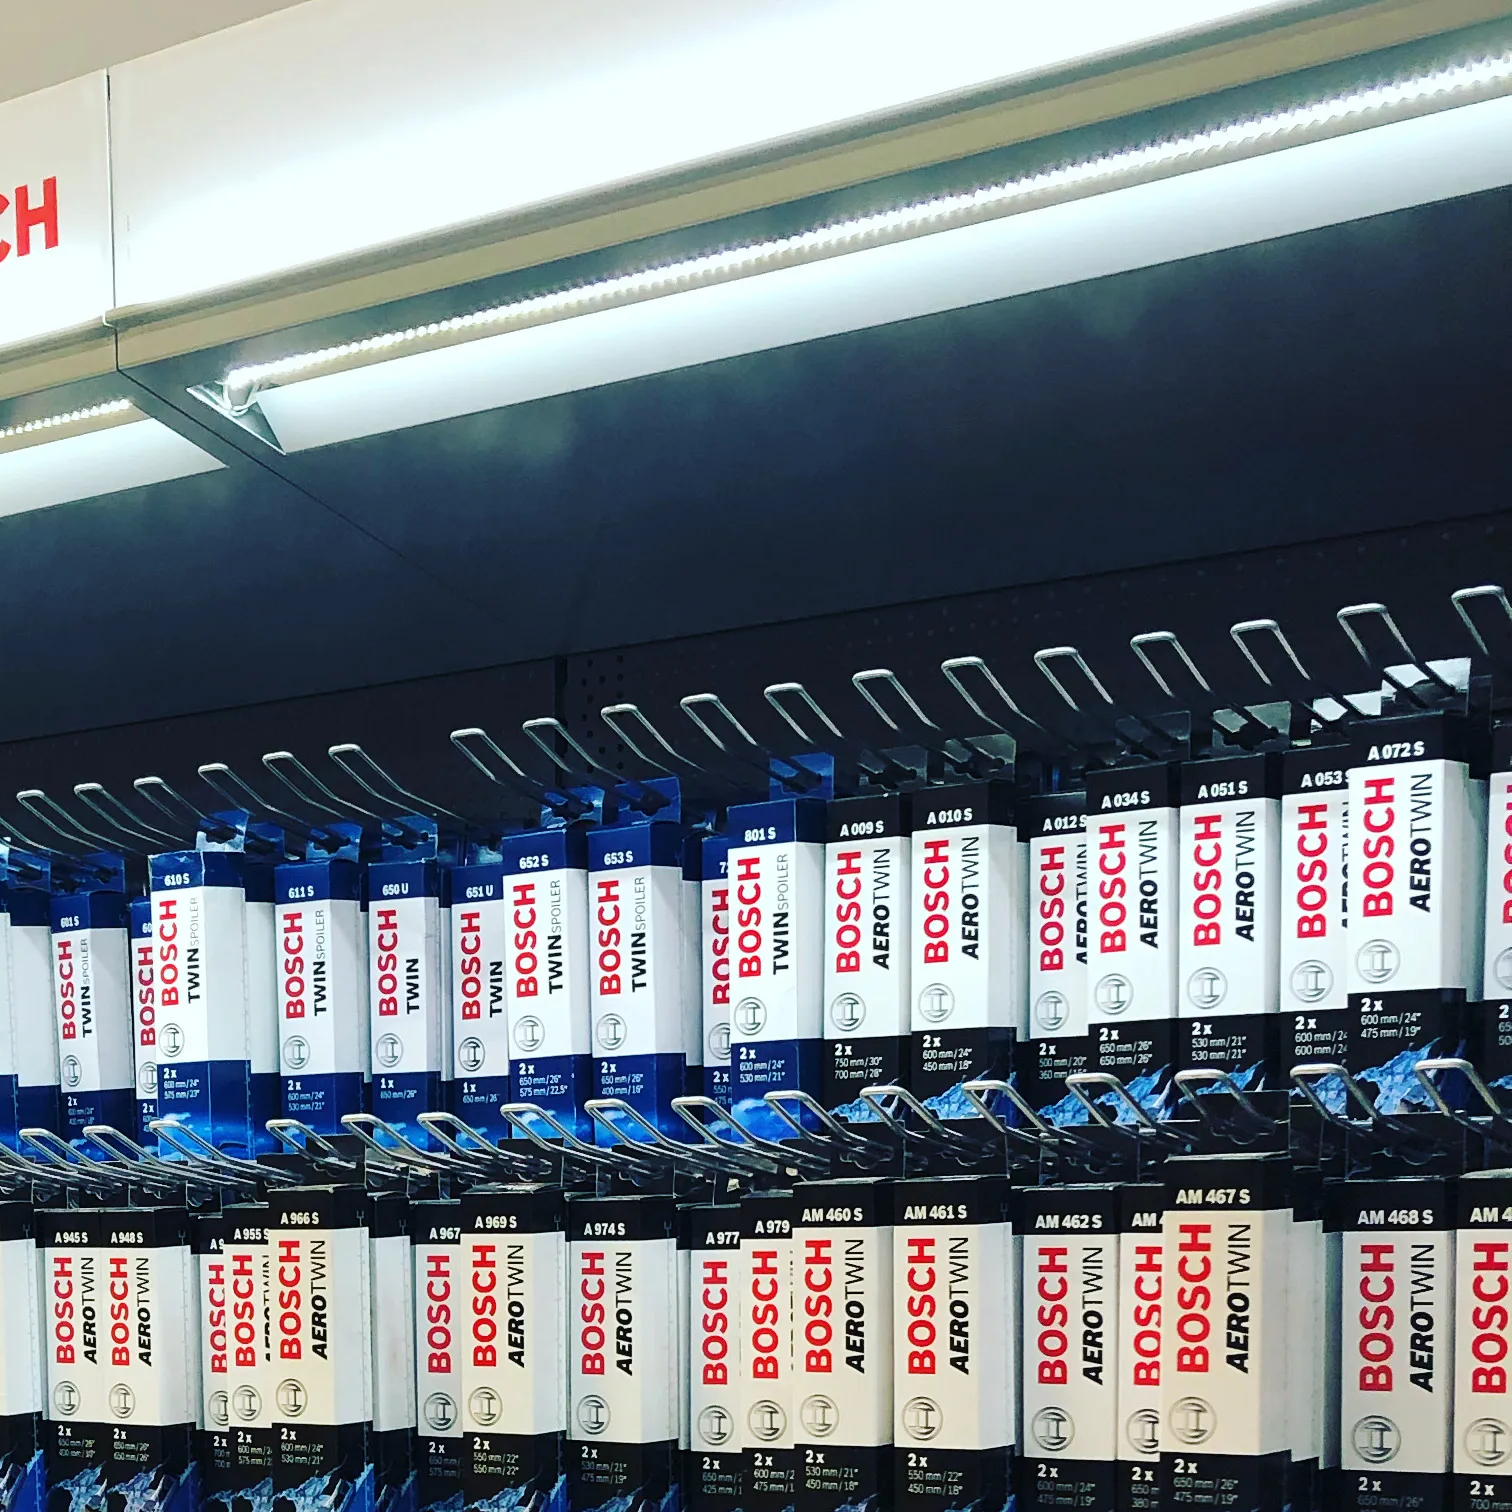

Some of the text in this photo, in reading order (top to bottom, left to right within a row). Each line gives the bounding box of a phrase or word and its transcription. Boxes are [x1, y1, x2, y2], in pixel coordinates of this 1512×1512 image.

[1198, 781, 1247, 798] A 051 S
[1368, 741, 1424, 760] A 072 S
[520, 855, 548, 869] 652 S
[745, 827, 776, 842] 801 S
[927, 808, 972, 824] A 010 S
[1364, 778, 1394, 916] BOSCH
[1410, 774, 1432, 912] AEROTWIN
[164, 873, 189, 886] 610 S
[466, 885, 493, 898] 651 U
[738, 858, 761, 977] BOSCH
[924, 840, 949, 963] BOSCH
[962, 837, 979, 960] AEROTWIN
[1194, 815, 1221, 946] BOSCH
[1236, 811, 1255, 941] AEROTWIN
[160, 900, 179, 1006] BOSCH
[462, 912, 480, 1019] BOSCH
[490, 961, 502, 1018] TWIN
[514, 884, 538, 997] BOSCH
[281, 1212, 319, 1224] A 966 S
[475, 1216, 517, 1228] A 969 S
[904, 1205, 967, 1219] AM 461 S
[1176, 1189, 1250, 1204] AM 467 S
[1358, 1210, 1433, 1224] AM 468 S
[279, 1241, 301, 1359] BOSCH
[311, 1241, 327, 1360] AEROTWIN
[472, 1245, 496, 1366] BOSCH
[508, 1246, 524, 1368] AEROTWIN
[908, 1238, 936, 1374] BOSCH
[949, 1238, 969, 1375] AEROTWIN
[1177, 1224, 1211, 1372] BOSCH
[1226, 1225, 1250, 1373] AEROTWIN
[1360, 1244, 1394, 1391] BOSCH
[1410, 1245, 1434, 1393] AEROTWIN
